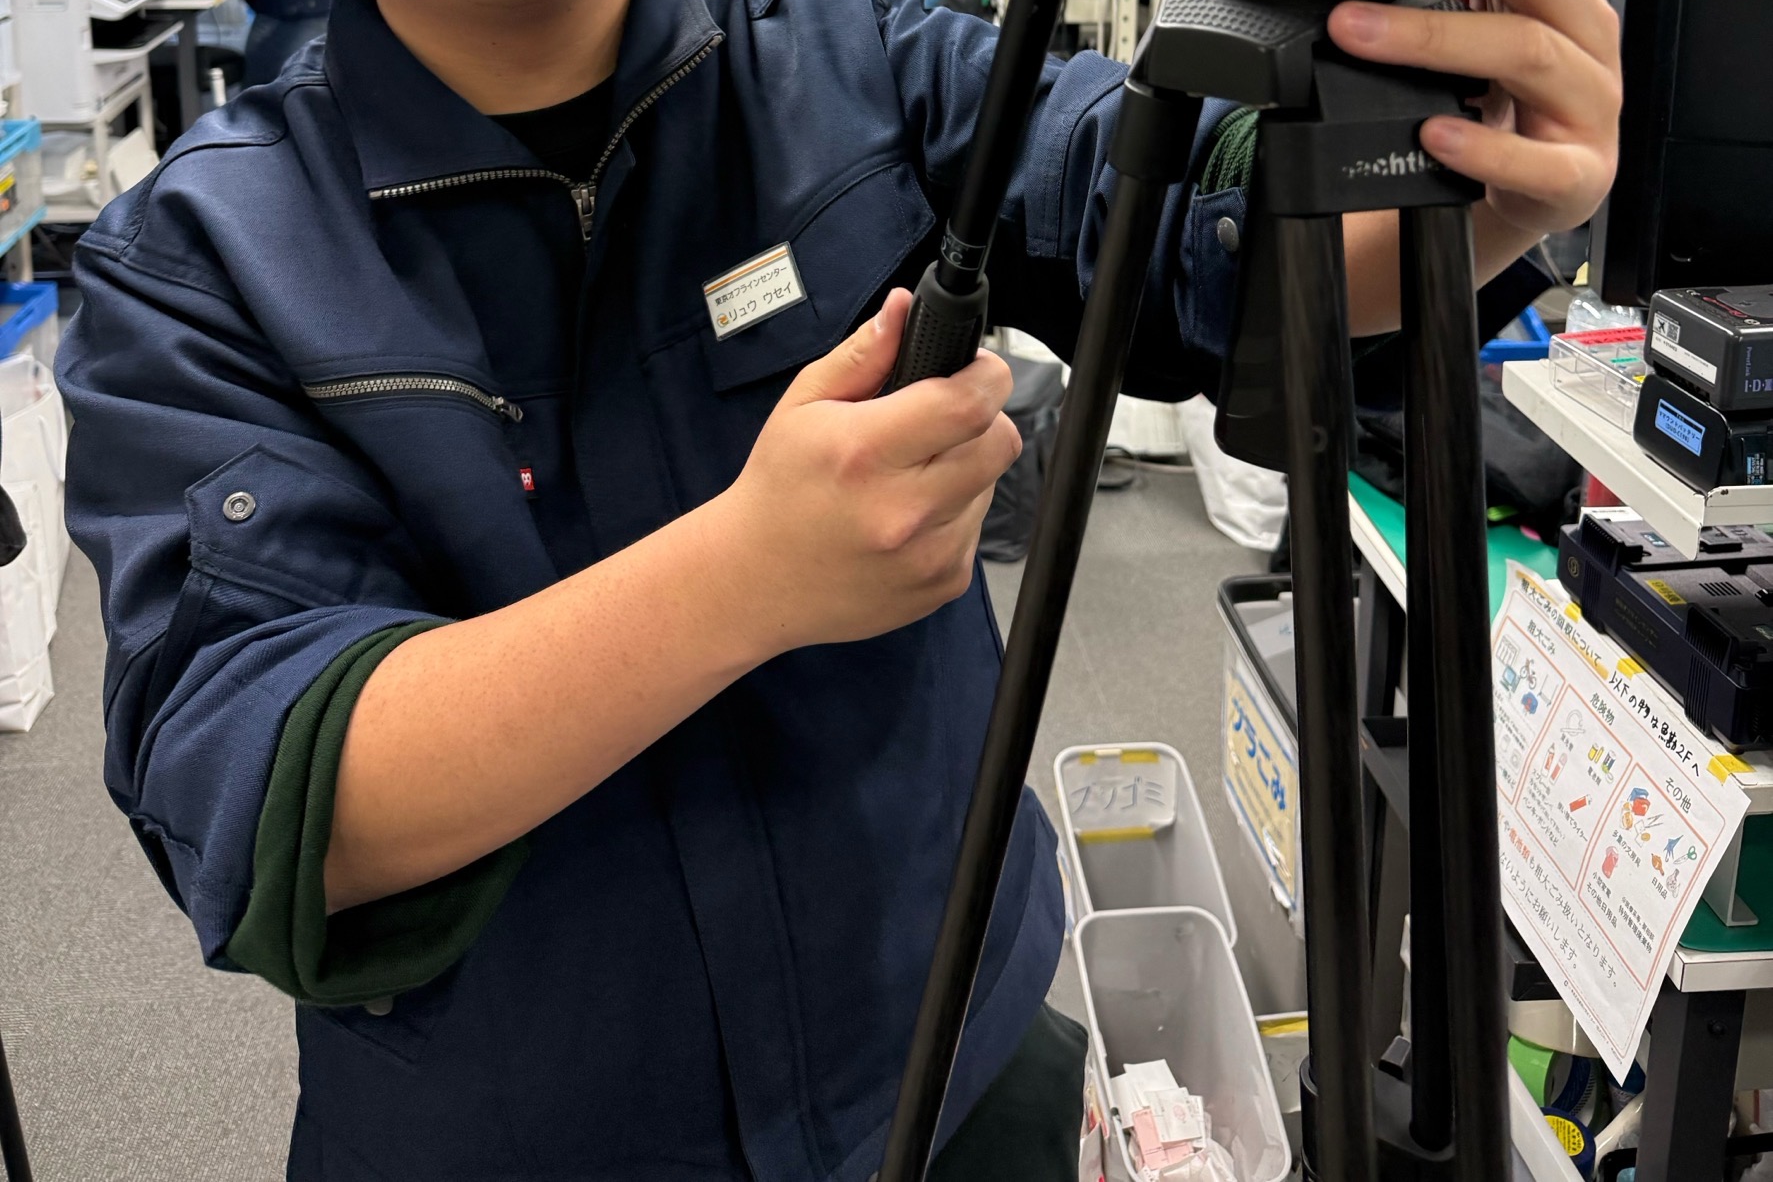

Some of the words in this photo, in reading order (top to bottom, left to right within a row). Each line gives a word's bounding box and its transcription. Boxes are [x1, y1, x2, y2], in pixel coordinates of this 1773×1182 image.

[714, 266, 787, 306] 東京オフラインセンター
[728, 299, 757, 321] リュウ
[762, 282, 791, 304] ウセイ
[1521, 578, 1602, 667] 粗大ごみの回収について
[1527, 619, 1556, 655] 粗大ごみ
[1590, 692, 1615, 726] 危険物
[1665, 777, 1692, 814] その他
[1612, 829, 1641, 868] 多量の文房具
[1592, 871, 1612, 899] 小型家電
[1651, 876, 1668, 900] 日用品
[1586, 882, 1618, 928] その他日用品
